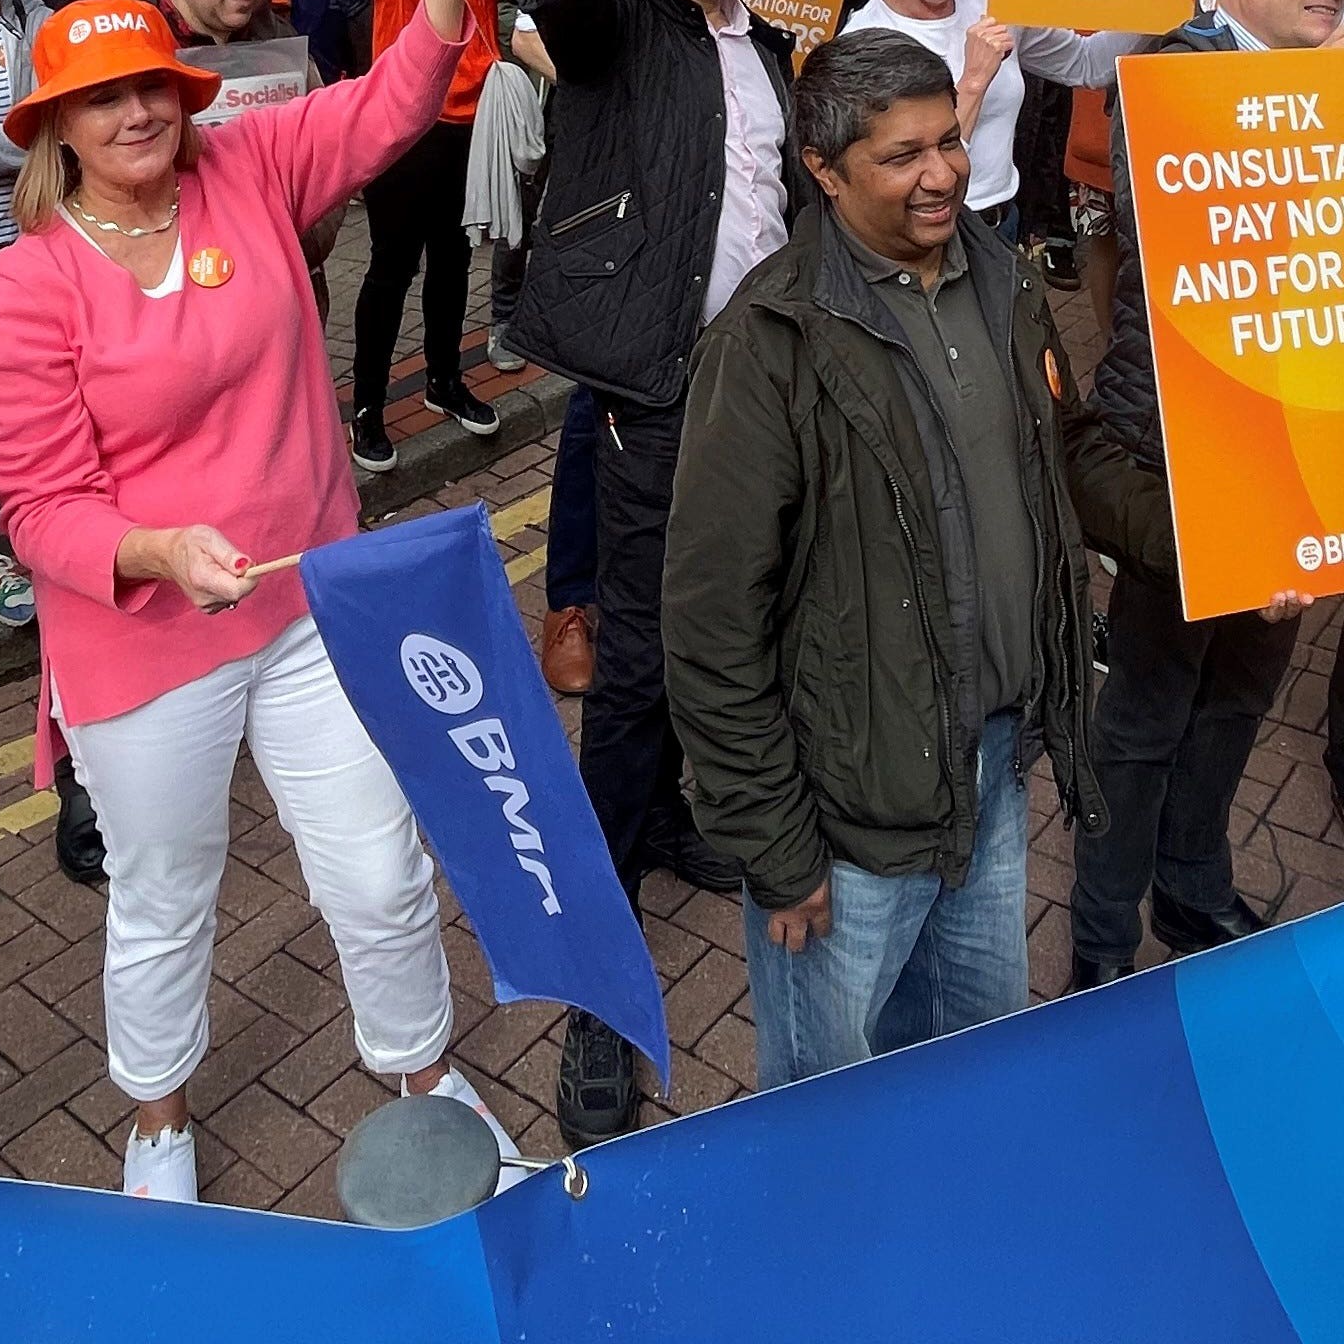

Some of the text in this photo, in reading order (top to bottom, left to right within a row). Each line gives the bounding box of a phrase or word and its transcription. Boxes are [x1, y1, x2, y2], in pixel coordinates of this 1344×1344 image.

[94, 11, 152, 38] BMA
[800, 3, 833, 24] FOR
[225, 82, 300, 108] Socialist
[1236, 93, 1324, 132] #FIX
[1207, 203, 1278, 245] PAY
[1172, 261, 1258, 306] AND
